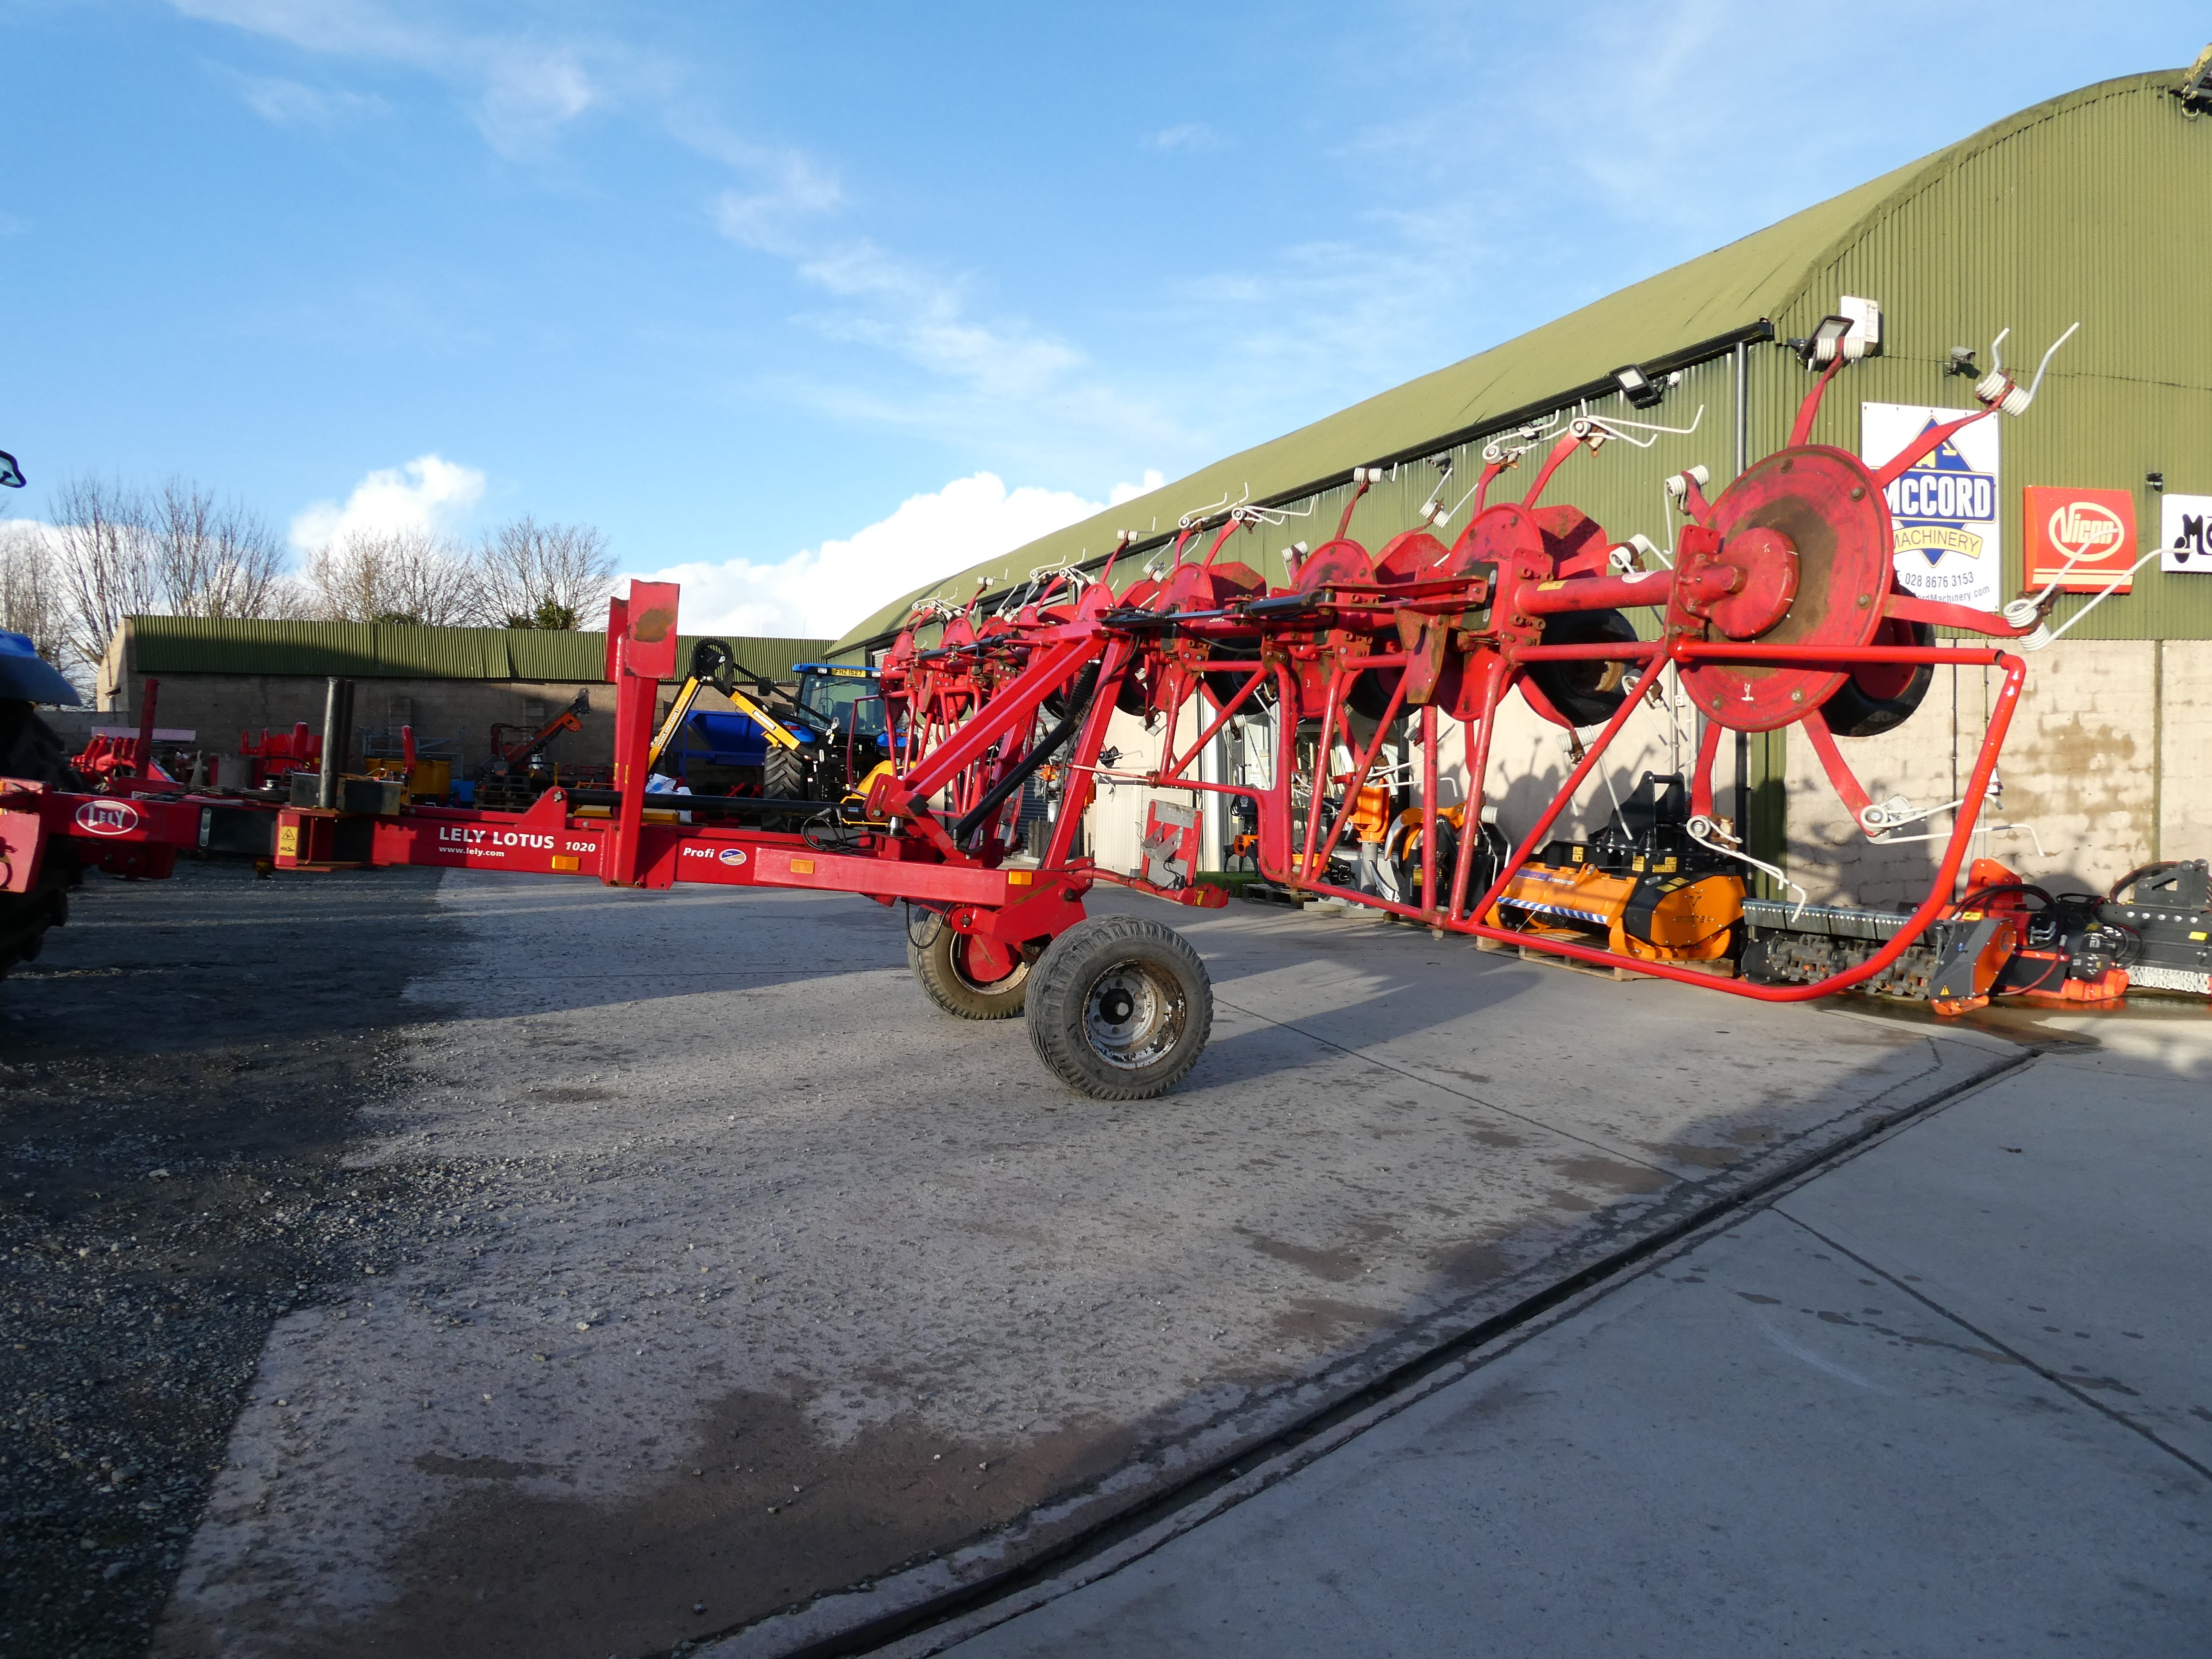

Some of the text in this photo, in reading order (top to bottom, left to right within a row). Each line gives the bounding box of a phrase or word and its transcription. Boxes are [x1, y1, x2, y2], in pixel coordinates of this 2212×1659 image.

[2060, 502, 2114, 544] Vicon
[1905, 573, 1922, 587] 028
[1926, 576, 1948, 588] 8676
[1951, 571, 1974, 587] 3153
[88, 806, 126, 829] LELY
[439, 827, 596, 853] LELY LOTUS 1020
[439, 847, 505, 857] www.lely.com
[683, 847, 715, 858] Profi
